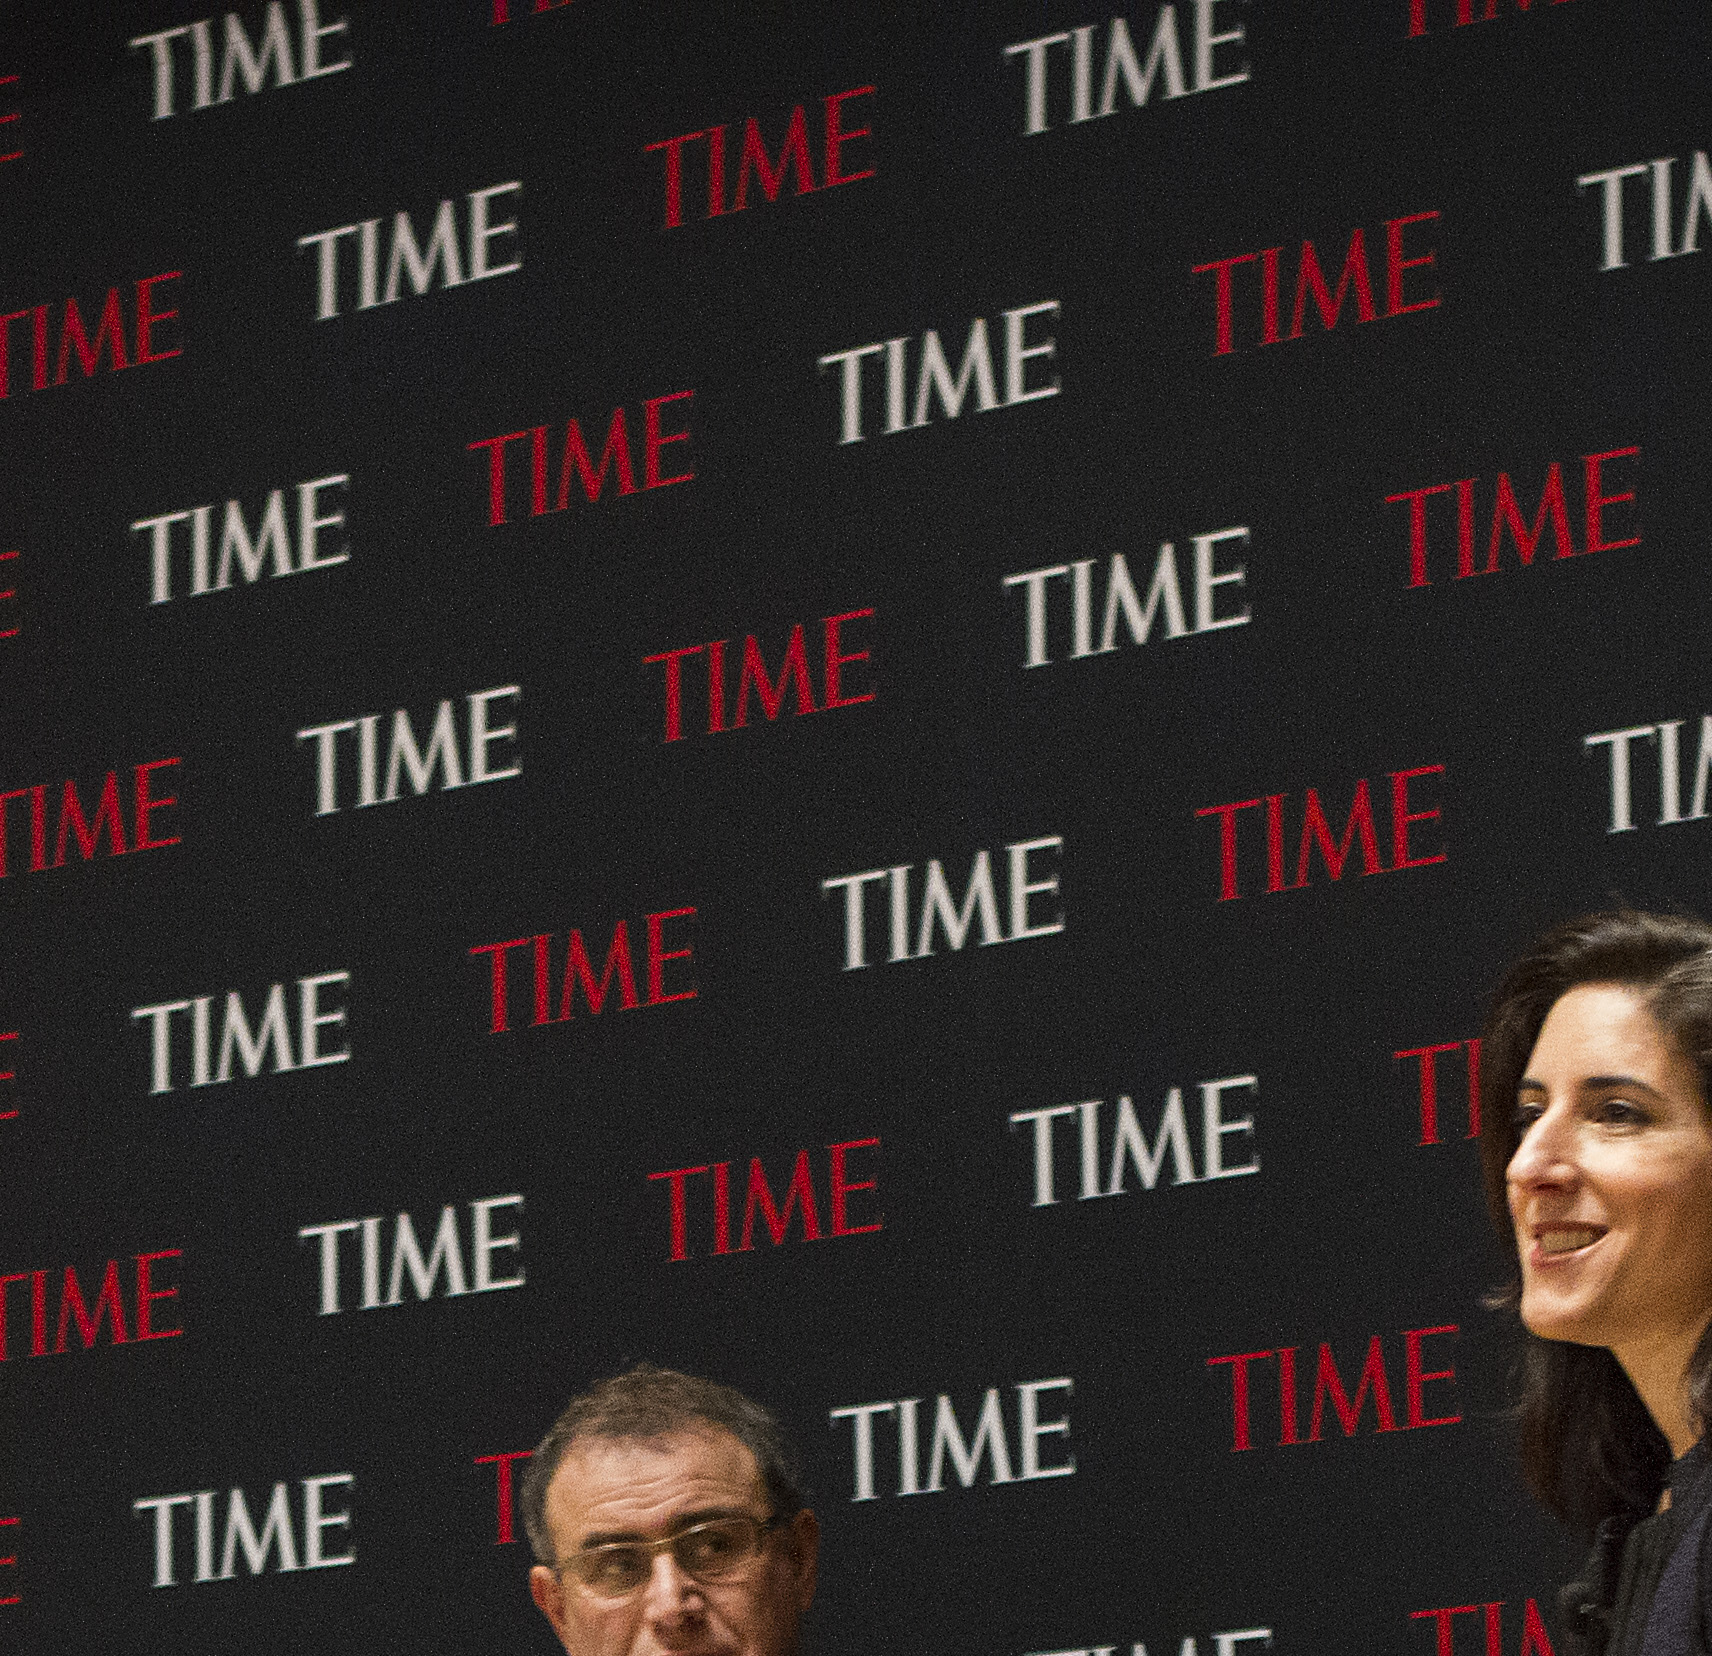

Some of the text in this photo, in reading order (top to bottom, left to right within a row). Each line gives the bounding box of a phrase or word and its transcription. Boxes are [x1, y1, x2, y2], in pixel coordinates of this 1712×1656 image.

[131, 0, 351, 119] TIME
[1004, 0, 1249, 134] TIME
[644, 85, 875, 228] TIME
[298, 181, 521, 320] TIME
[1192, 210, 1440, 355] TIME
[819, 301, 1060, 444] TIME
[468, 390, 694, 526] TIME
[1385, 446, 1641, 587] TIME
[131, 474, 349, 604] TIME
[1003, 526, 1250, 668] TIME
[643, 608, 875, 742] TIME
[296, 685, 521, 815] TIME
[1196, 764, 1446, 901] TIME
[822, 836, 1064, 970] TIME
[131, 971, 350, 1094] TIME
[470, 906, 697, 1033] TIME
[647, 1137, 882, 1261] TIME
[1010, 1075, 1259, 1206] TIME
[299, 1194, 525, 1314] TIME
[830, 1378, 1075, 1501] TIME
[1207, 1324, 1462, 1451] TIME
[134, 1473, 355, 1586] TIME
